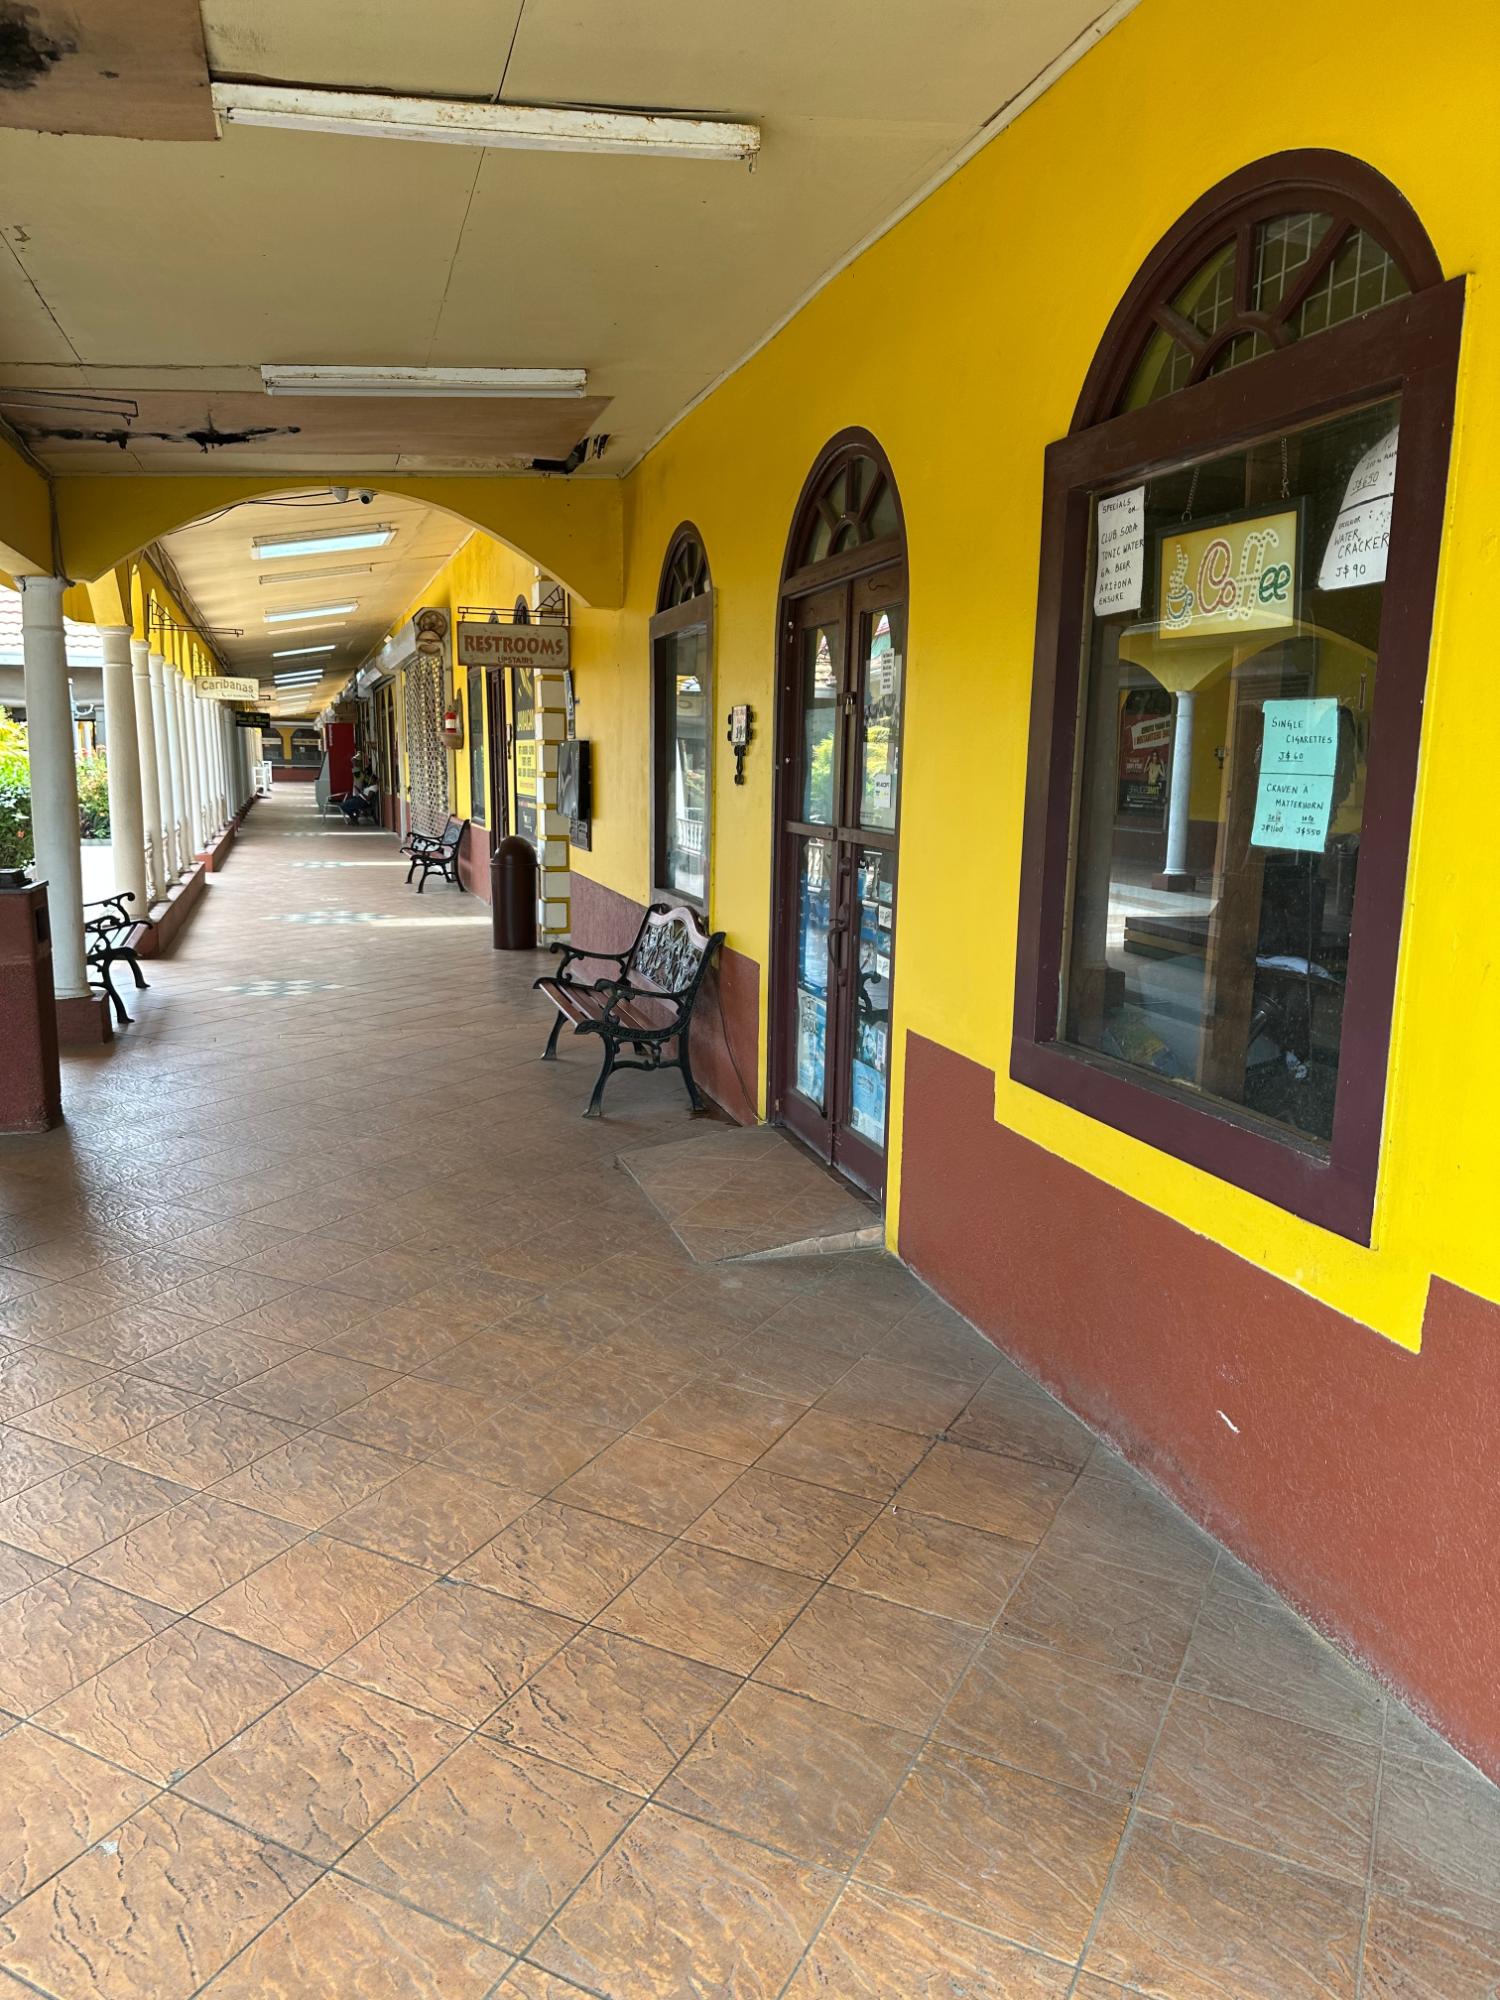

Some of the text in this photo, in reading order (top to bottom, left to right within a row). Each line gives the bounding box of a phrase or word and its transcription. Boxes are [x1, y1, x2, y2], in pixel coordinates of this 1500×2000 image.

[1102, 498, 1131, 513] SPECIALS
[1101, 522, 1138, 544] CLUB SODA
[1102, 539, 1144, 560] TONIC WATER
[1338, 532, 1390, 559] CRACKER
[1114, 560, 1131, 573] BEER
[1099, 577, 1132, 594] ARIZONA
[1099, 592, 1124, 605] ENSURE
[464, 635, 564, 655] RESTROOMS
[497, 656, 534, 665] UPSTAIRS
[202, 679, 254, 693] Caribanas
[1272, 717, 1304, 730] SINGLE
[1286, 735, 1333, 744] CIGARETTES
[1266, 783, 1299, 794] CRAVEN
[1275, 799, 1324, 810] MATTERHORN
